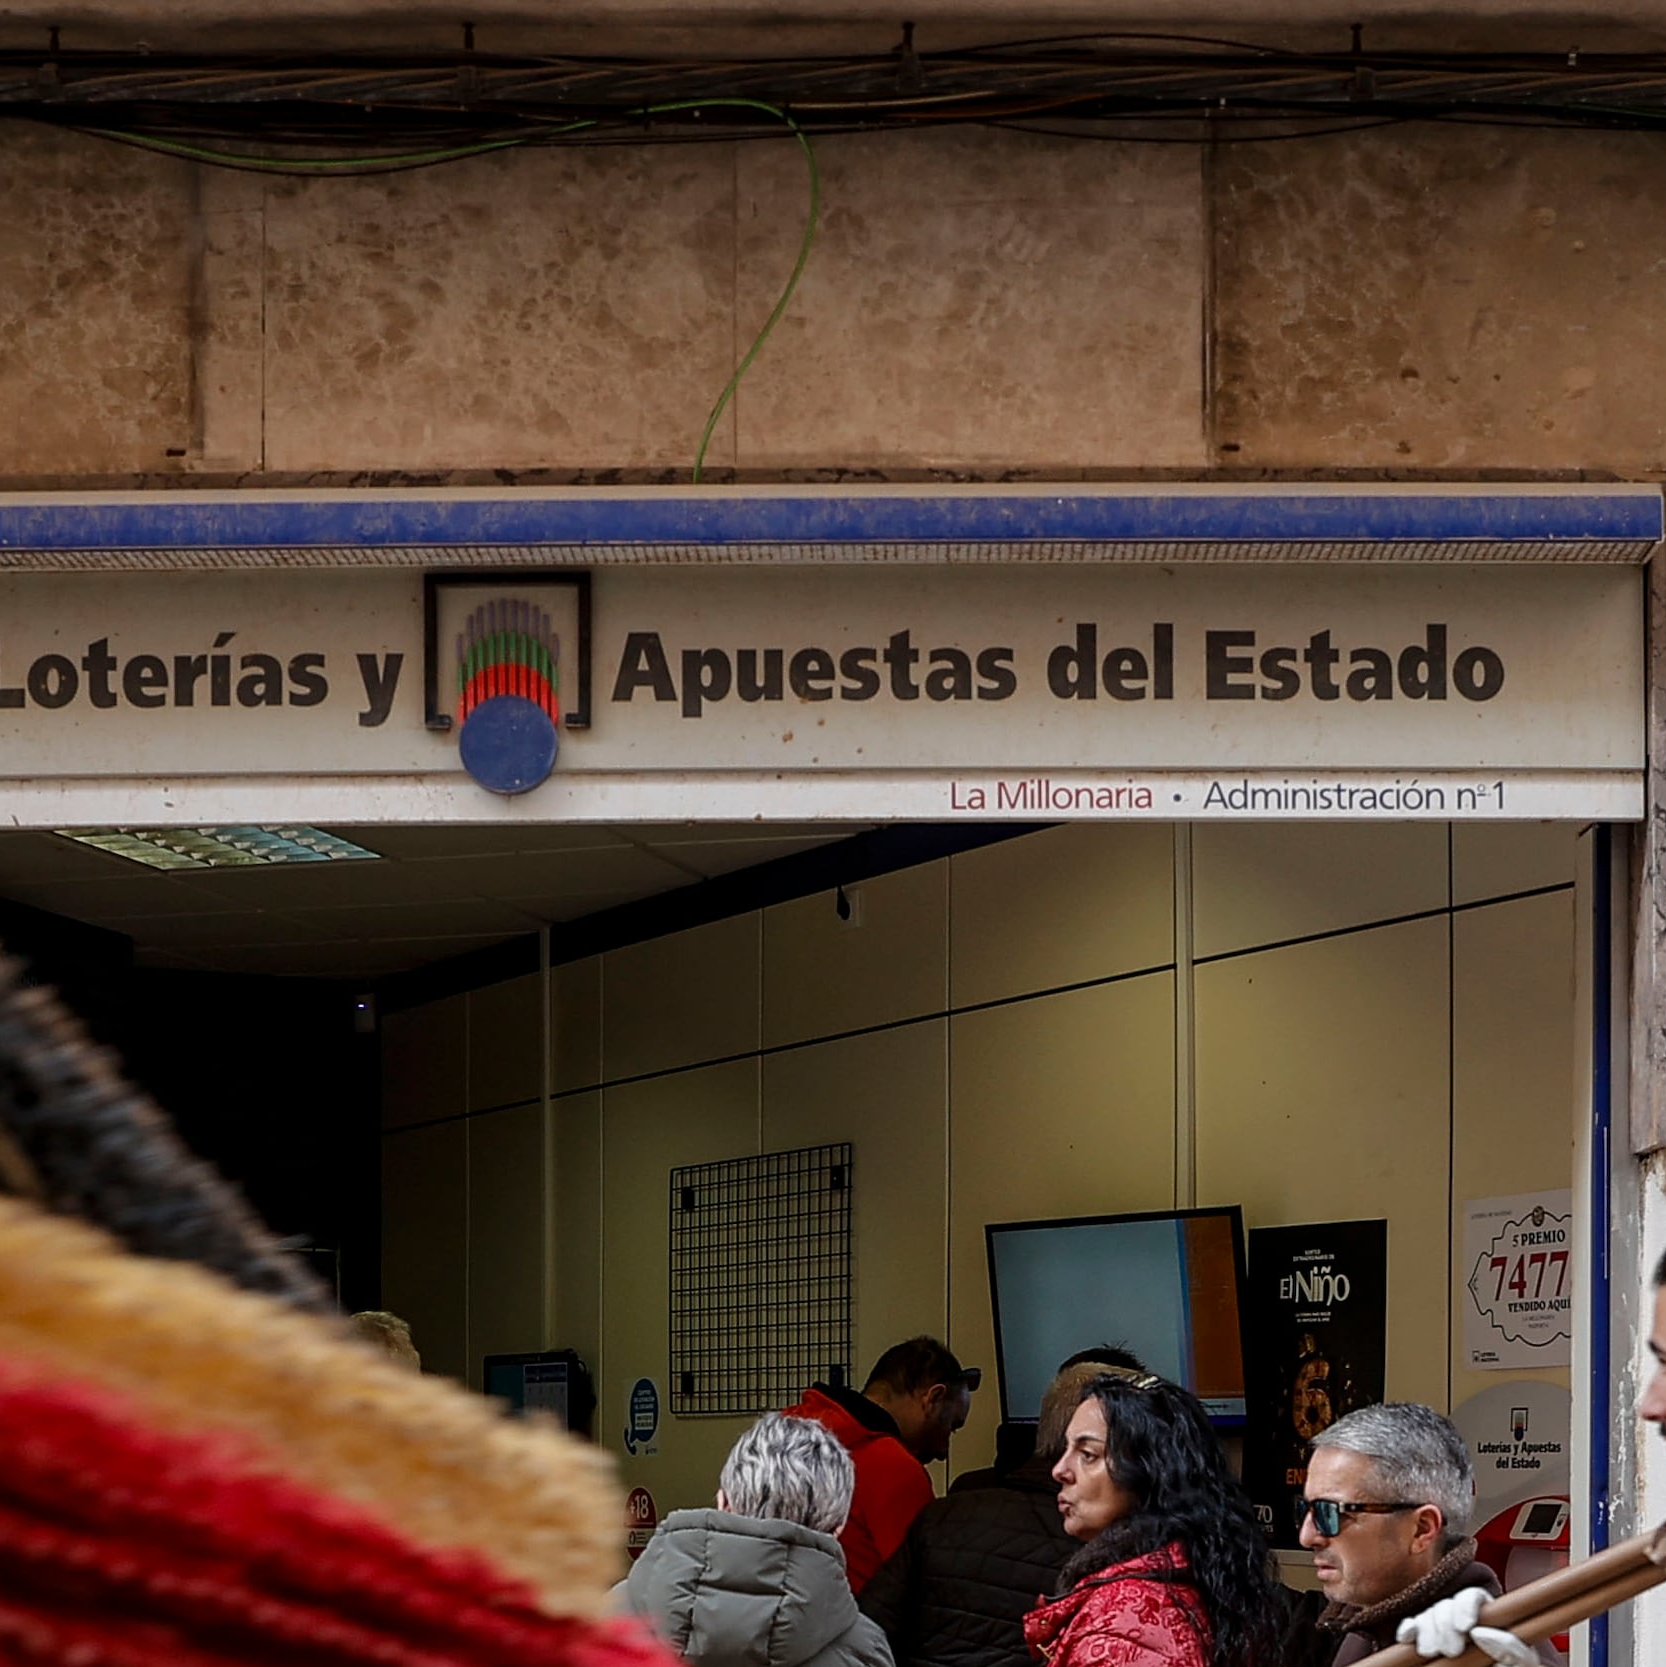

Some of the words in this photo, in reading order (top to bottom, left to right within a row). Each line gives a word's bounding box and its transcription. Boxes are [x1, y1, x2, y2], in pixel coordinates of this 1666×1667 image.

[356, 652, 405, 728] y
[611, 629, 1018, 718] Apuestas
[1047, 622, 1174, 701] del
[1205, 622, 1505, 702] Estado
[950, 781, 985, 810] La
[997, 778, 1153, 810] Millonaria
[1203, 778, 1446, 811] Administración
[1512, 1234, 1520, 1247] 5
[1521, 1229, 1566, 1247] PREMIO
[1280, 1274, 1293, 1299] El
[1295, 1265, 1351, 1306] Niño
[1508, 1301, 1546, 1313] VENDIDO
[1513, 1444, 1519, 1456] y
[1521, 1441, 1561, 1455] Apuestas
[1496, 1456, 1509, 1469] del
[1511, 1456, 1541, 1469] Estado
